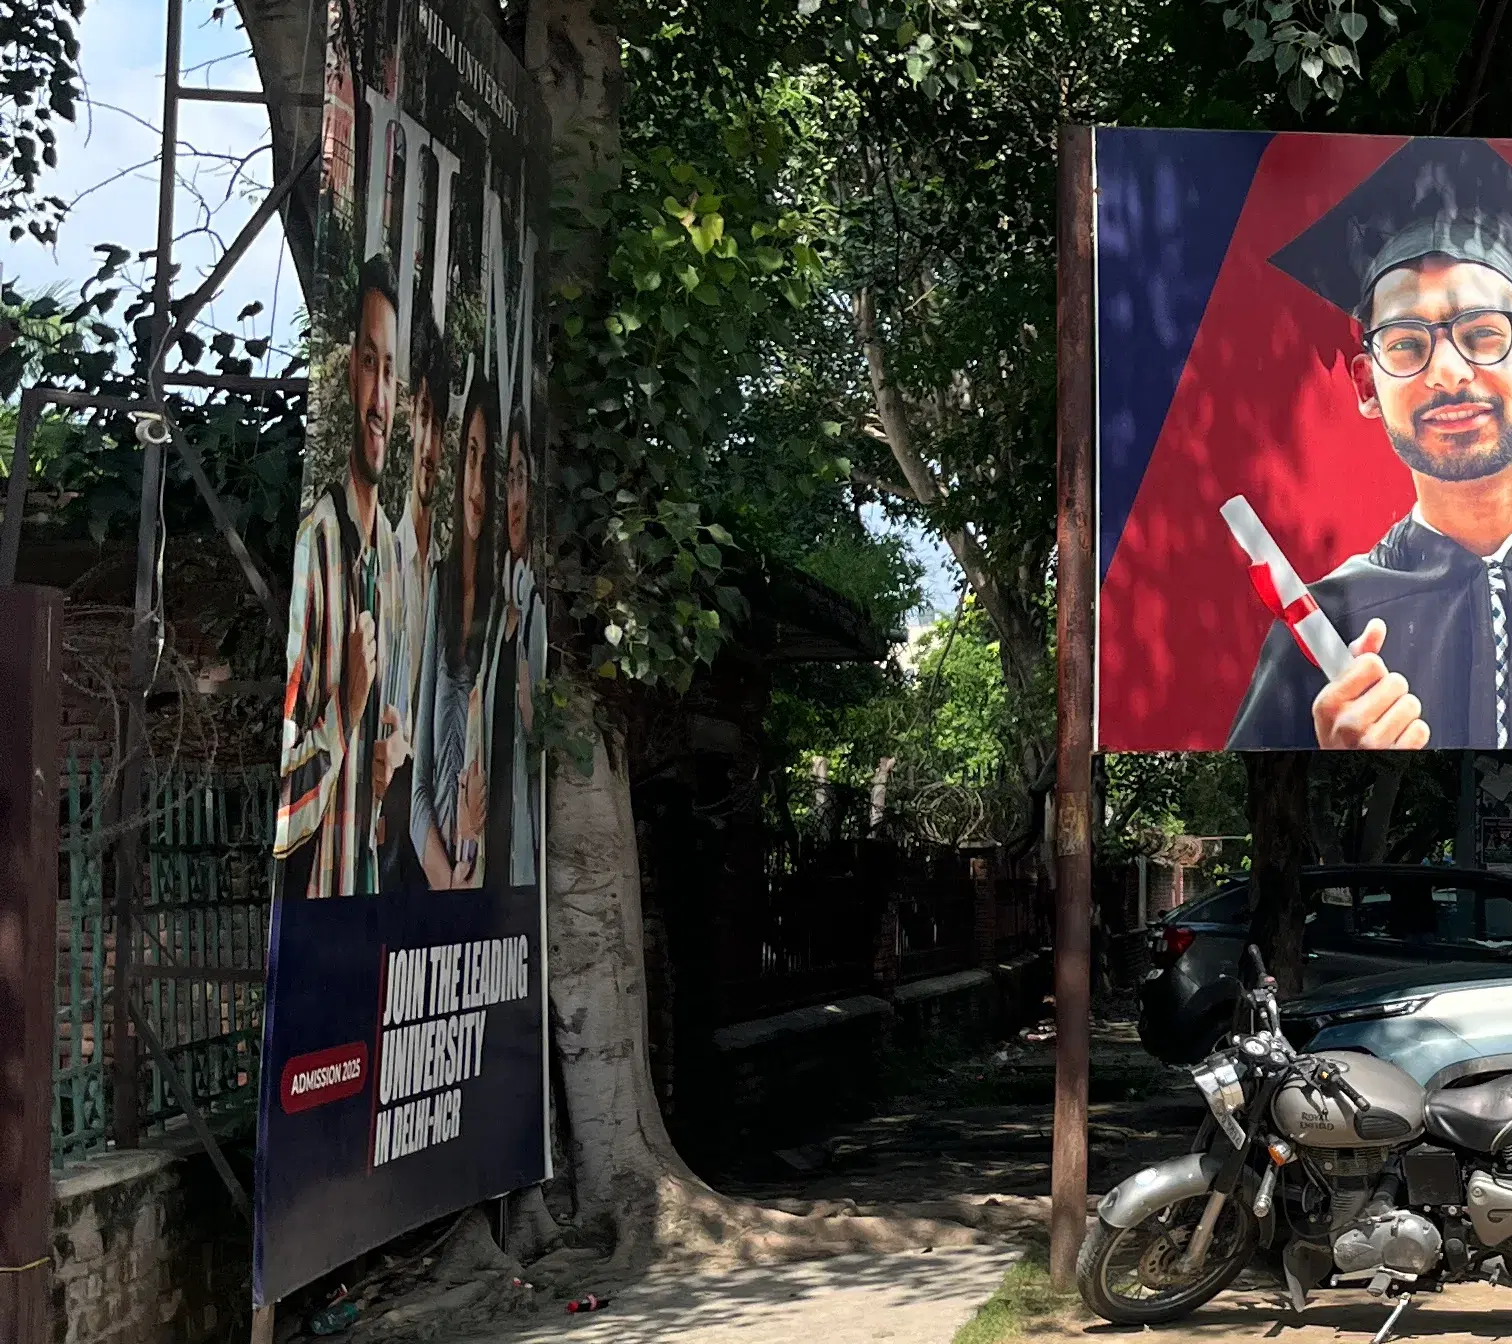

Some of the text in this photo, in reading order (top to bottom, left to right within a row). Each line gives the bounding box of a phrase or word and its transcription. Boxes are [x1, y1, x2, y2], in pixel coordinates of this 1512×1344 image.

[458, 41, 519, 136] UNIVERSITY
[383, 934, 529, 1027] JOIN THE LEADING
[290, 1057, 361, 1096] ADMISSION 2025
[379, 1010, 487, 1106] UNIVERSITY
[374, 1088, 462, 1168] IN DELHI-NCR
